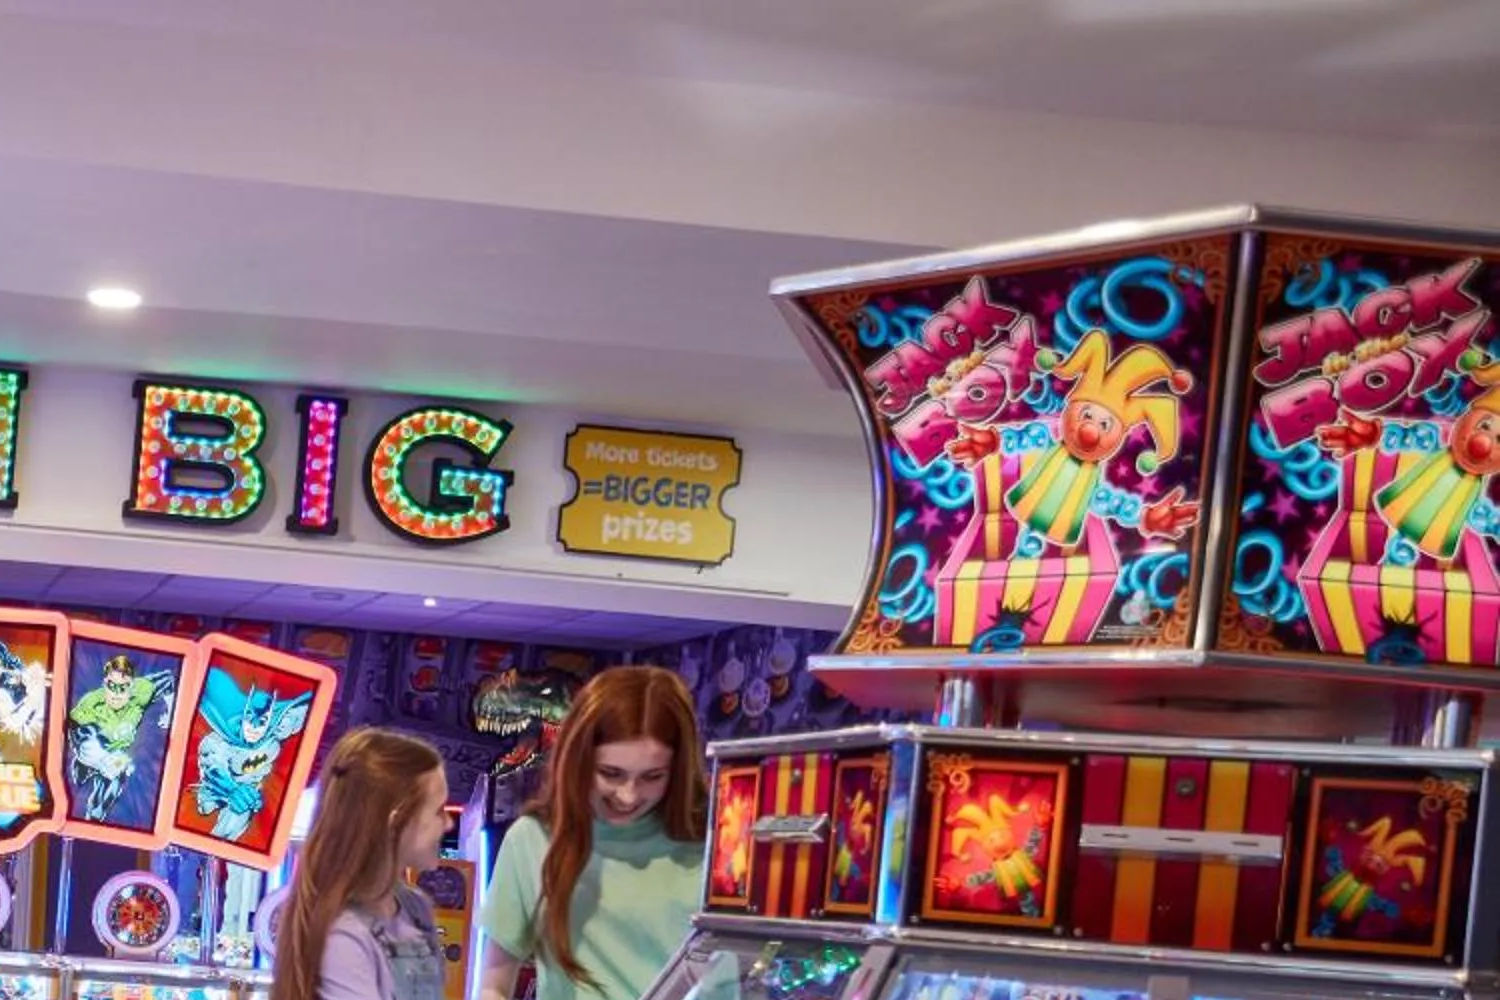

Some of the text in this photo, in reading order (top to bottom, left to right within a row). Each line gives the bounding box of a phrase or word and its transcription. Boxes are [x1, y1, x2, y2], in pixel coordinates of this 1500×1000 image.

[864, 274, 1020, 419] JACK
[892, 314, 1038, 467] BOX
[1253, 257, 1482, 387] JACK
[1260, 308, 1492, 452] BOX
[122, 379, 514, 546] BIG
[585, 441, 718, 472] More tickets
[601, 511, 694, 545] prizes
